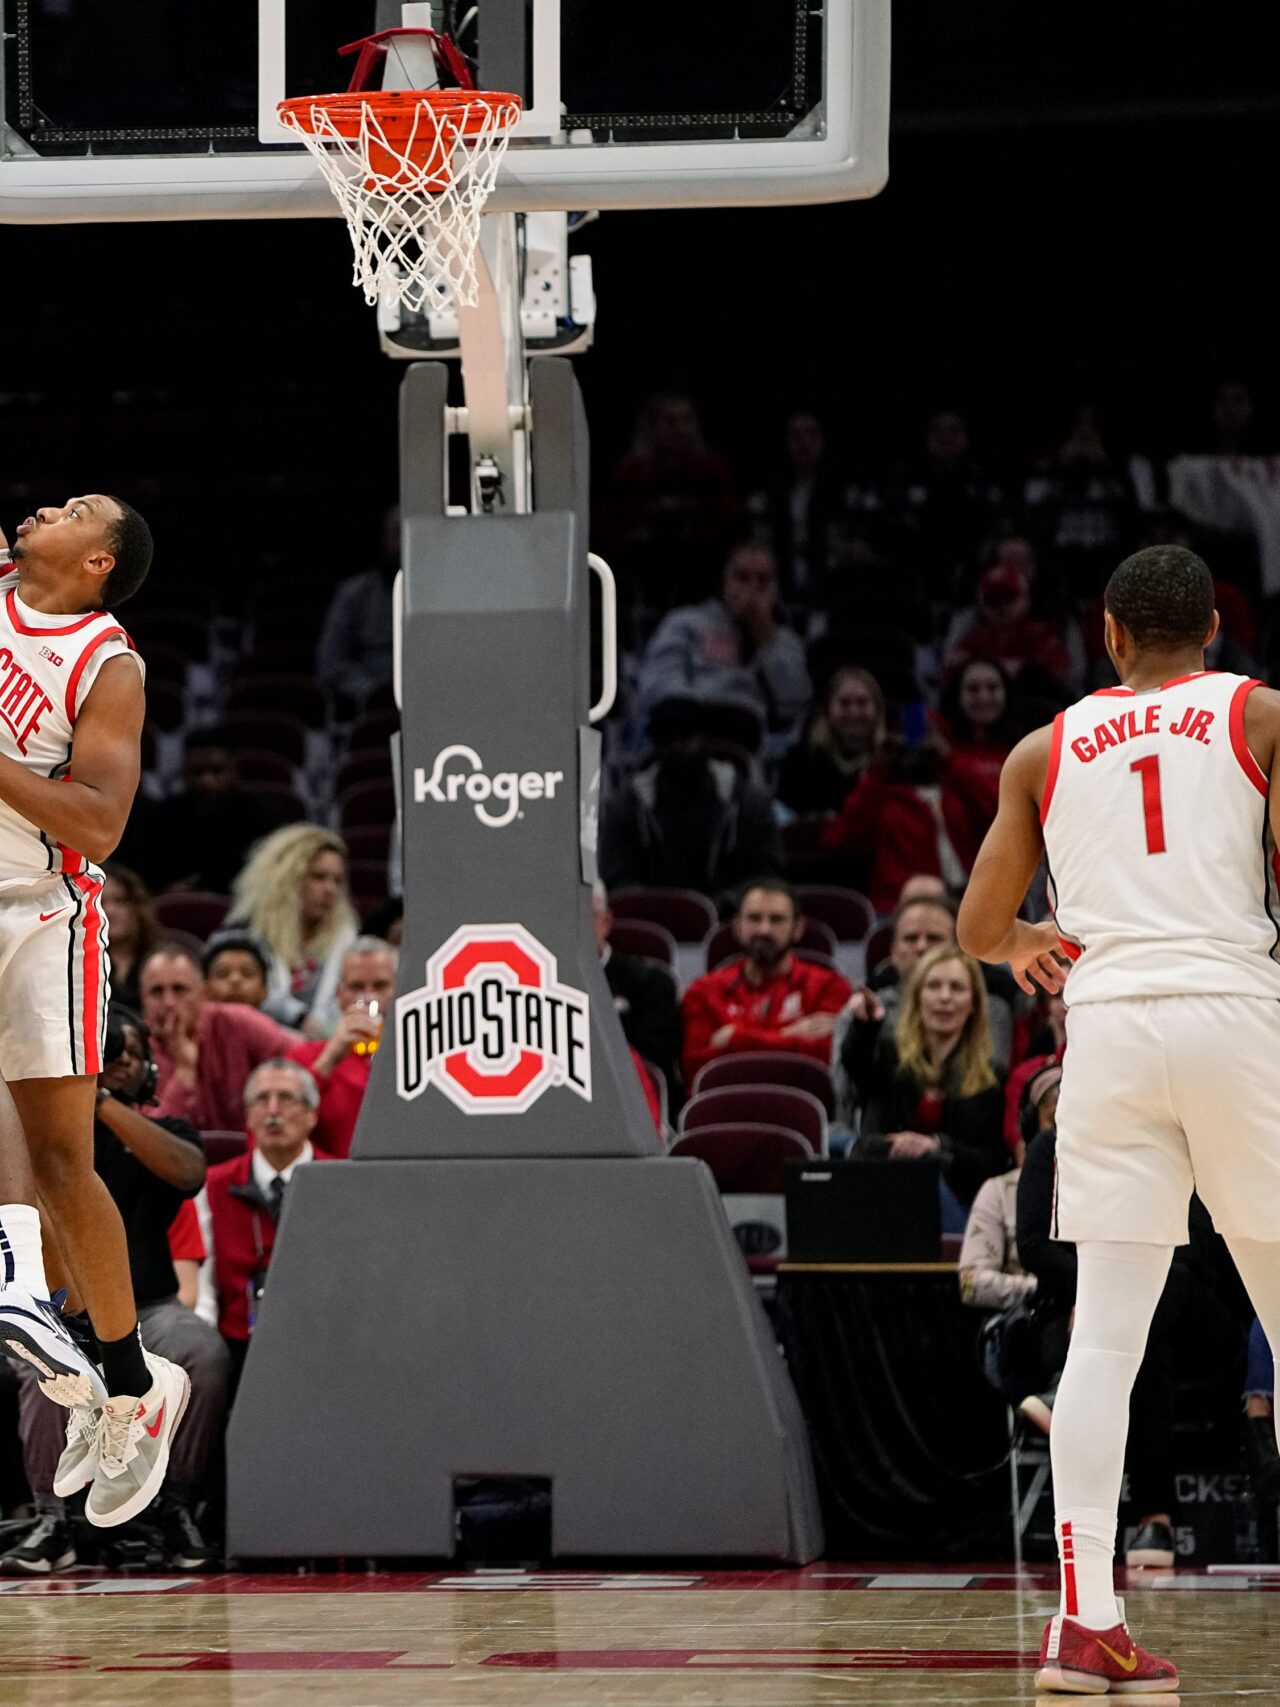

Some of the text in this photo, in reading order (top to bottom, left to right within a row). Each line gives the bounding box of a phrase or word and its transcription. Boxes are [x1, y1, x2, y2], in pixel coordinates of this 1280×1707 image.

[1070, 704, 1215, 763] GAYLE JR.
[414, 744, 564, 828] Kroger
[1129, 753, 1167, 857] 1
